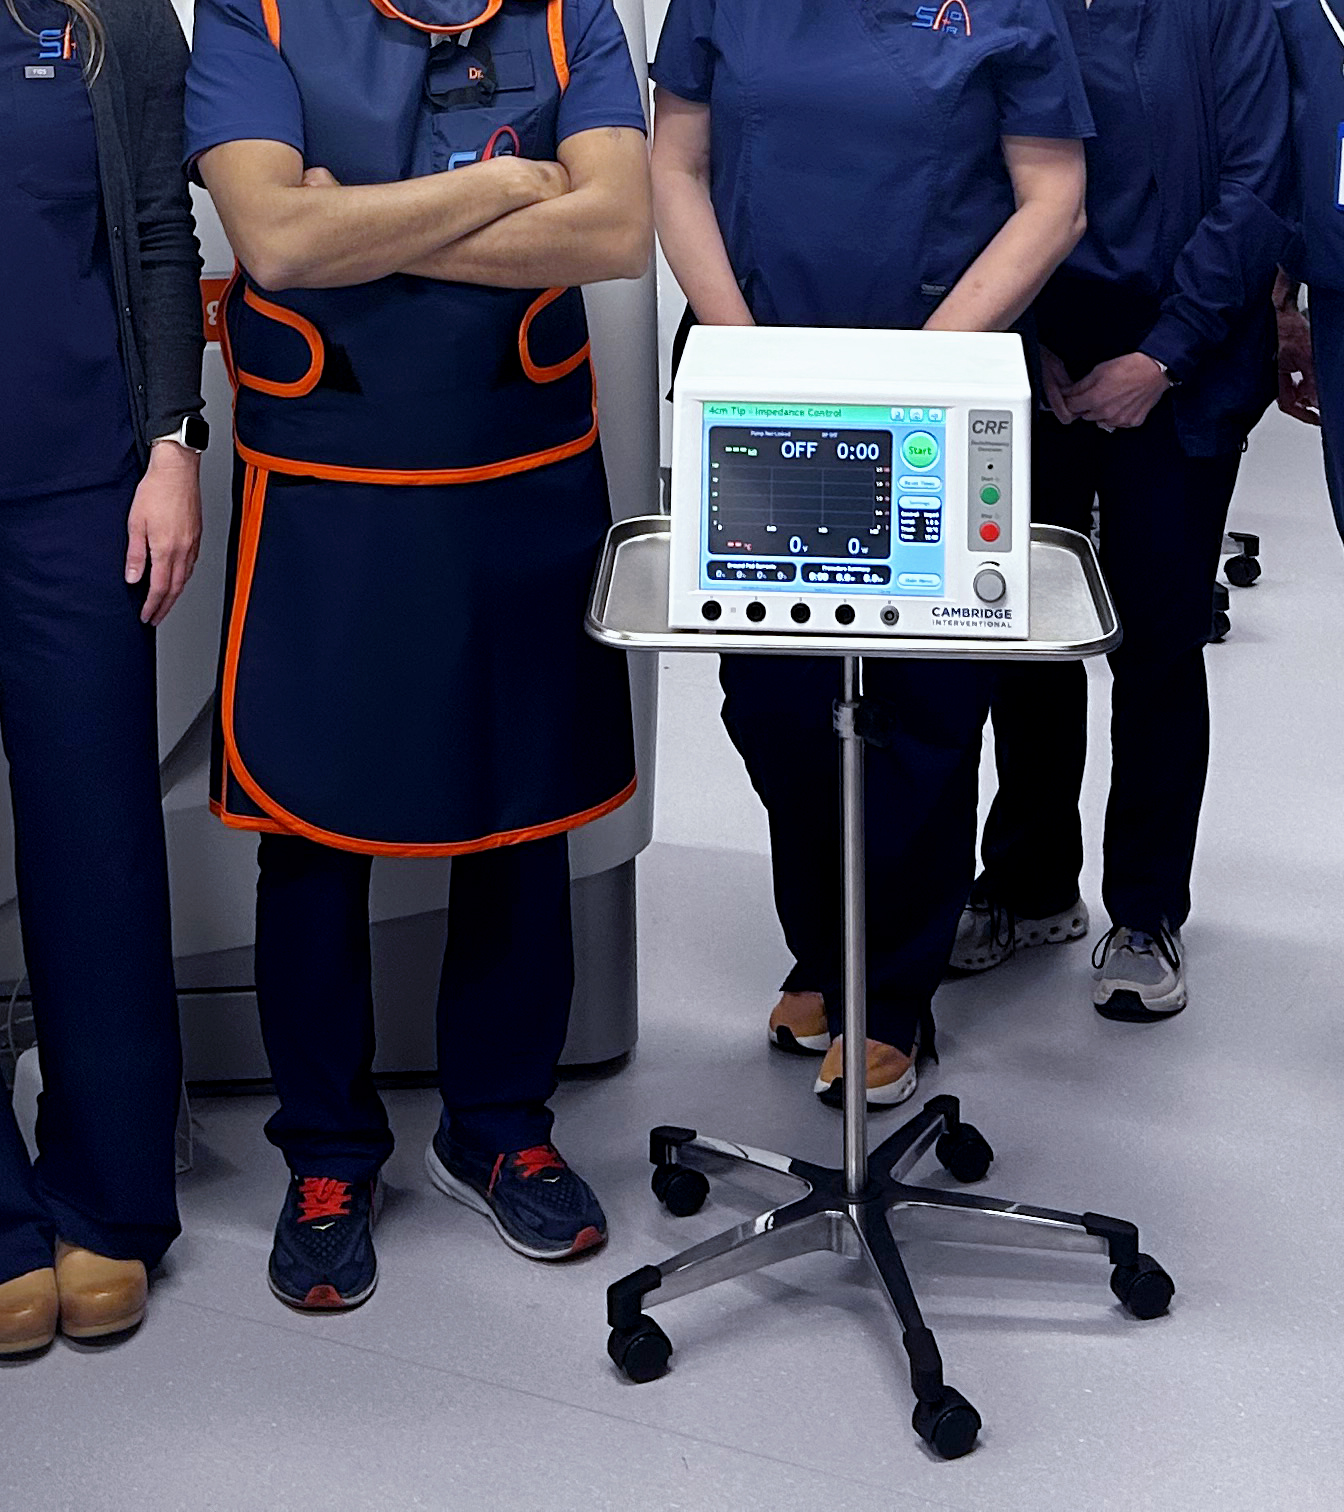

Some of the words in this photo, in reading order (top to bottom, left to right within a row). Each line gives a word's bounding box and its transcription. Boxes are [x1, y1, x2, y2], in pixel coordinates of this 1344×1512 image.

[730, 407, 746, 418] Tip
[755, 407, 805, 418] Impedance
[807, 408, 842, 418] Control
[972, 420, 1009, 435] CRF
[781, 440, 818, 459] OFF
[837, 442, 880, 460] 0:00
[908, 445, 932, 456] Start
[789, 535, 802, 553] 0
[847, 537, 860, 555] 0
[931, 606, 1012, 621] CAMBRIDGE
[932, 618, 1012, 629] INTERVENTIONAL
